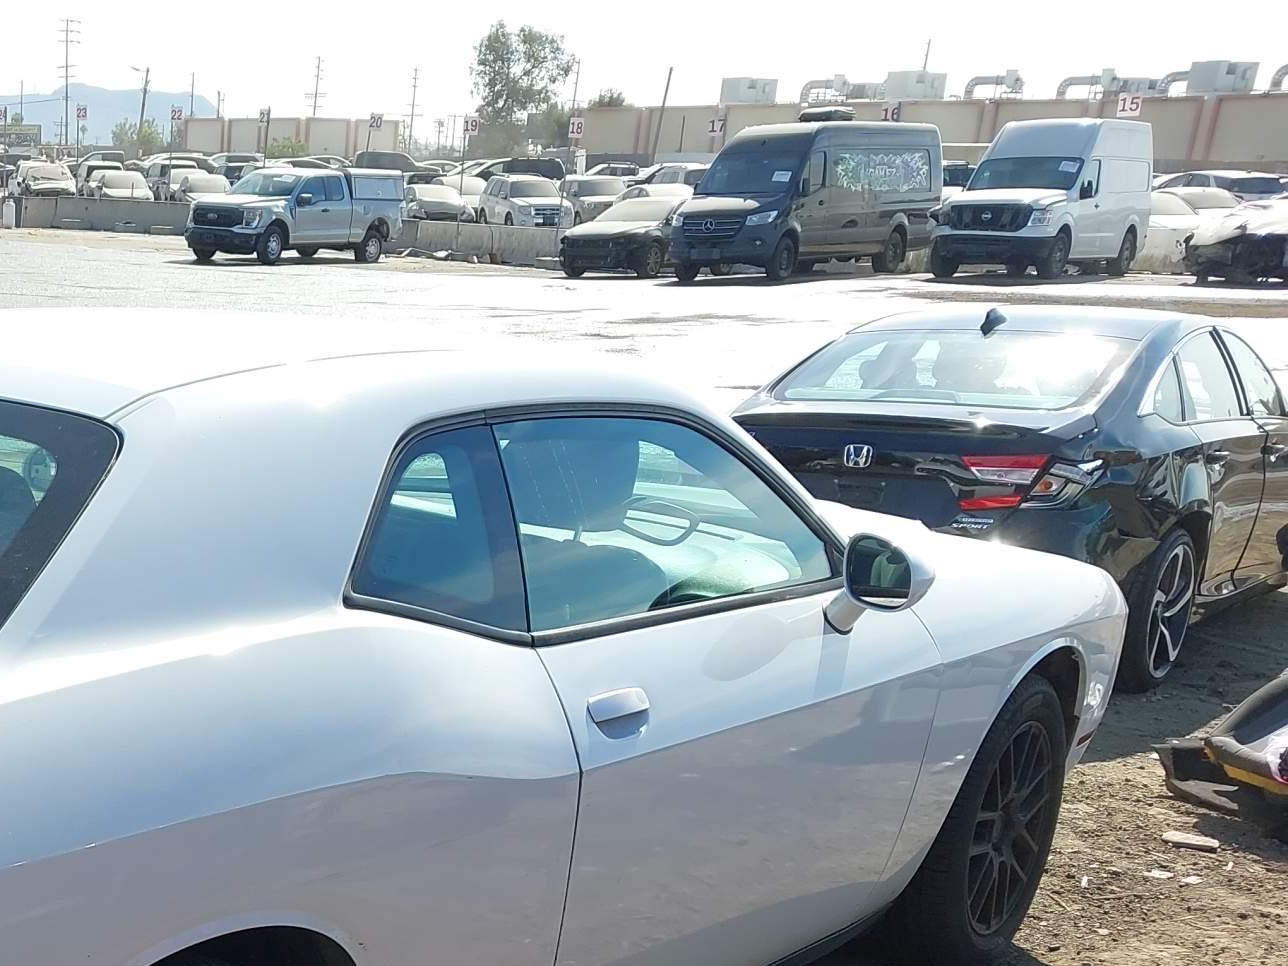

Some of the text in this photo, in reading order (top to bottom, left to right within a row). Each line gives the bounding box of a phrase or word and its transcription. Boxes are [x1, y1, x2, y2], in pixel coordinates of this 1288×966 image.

[1118, 96, 1141, 112] 15
[76, 107, 87, 118] 23
[171, 109, 182, 120] 22
[881, 107, 899, 122] 16
[369, 116, 382, 128] 20
[464, 120, 478, 132] 19
[569, 121, 583, 134] 18
[708, 119, 726, 132] 17
